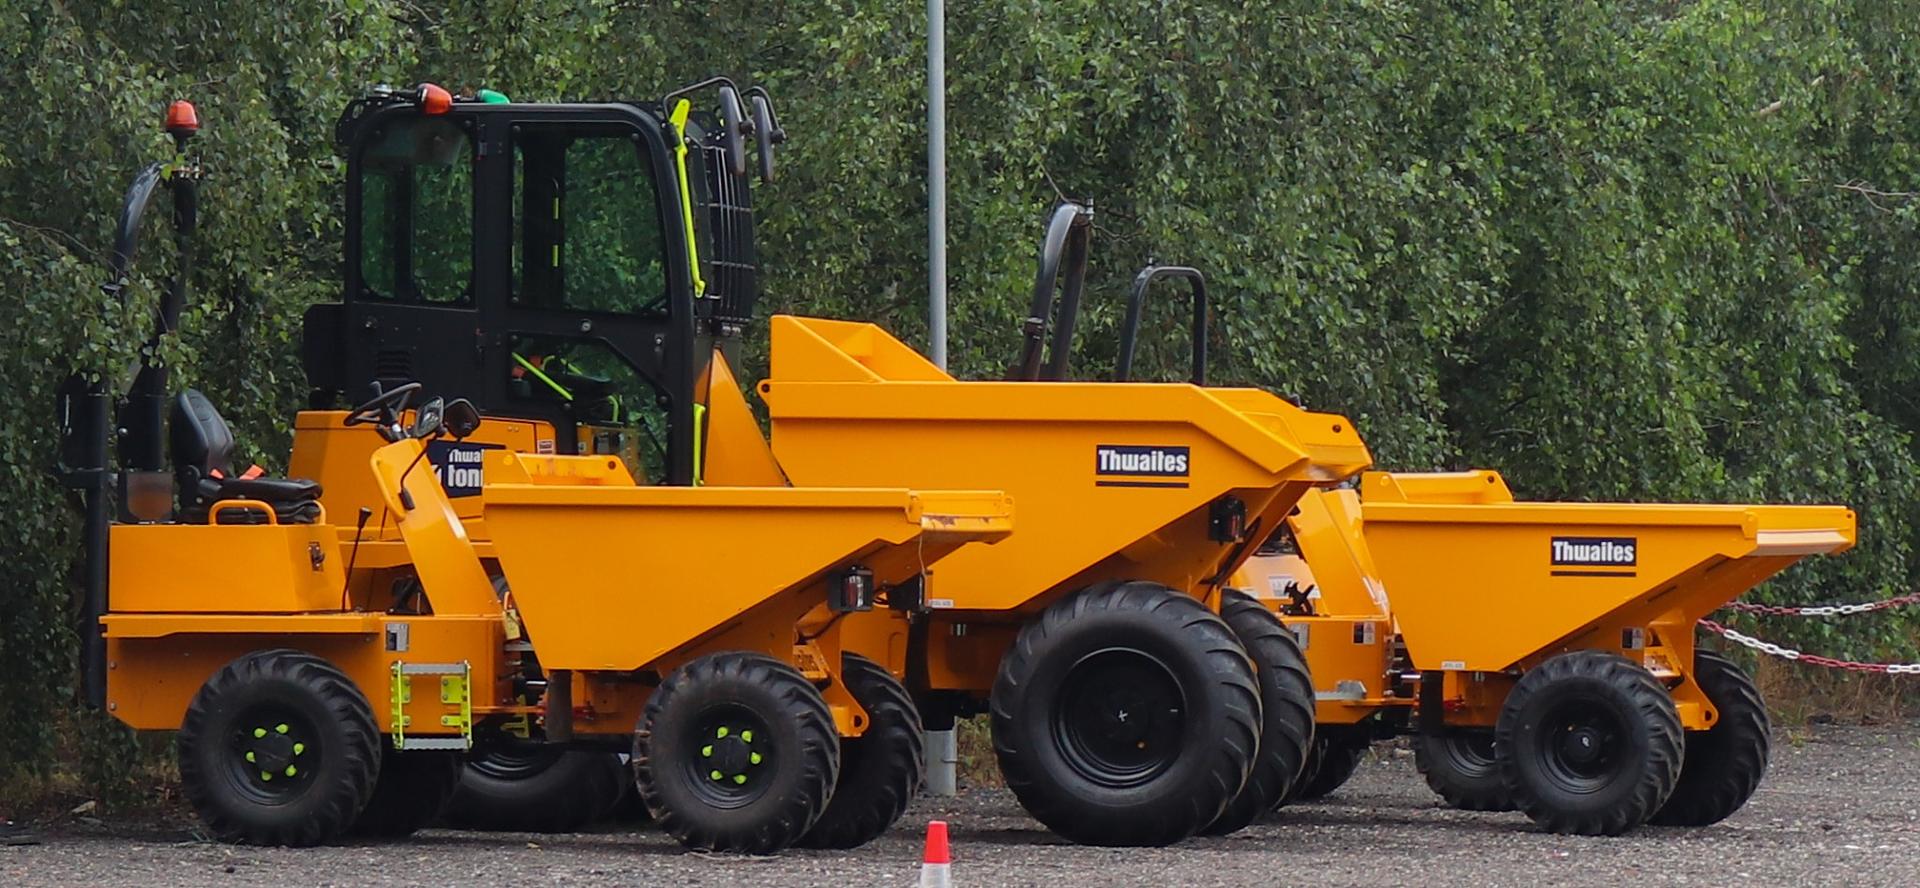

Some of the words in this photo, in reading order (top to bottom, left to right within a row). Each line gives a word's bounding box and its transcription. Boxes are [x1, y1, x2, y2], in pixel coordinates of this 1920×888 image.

[1098, 449, 1187, 472] Thwaites
[448, 464, 483, 487] ton
[1553, 541, 1634, 562] Thwaites
